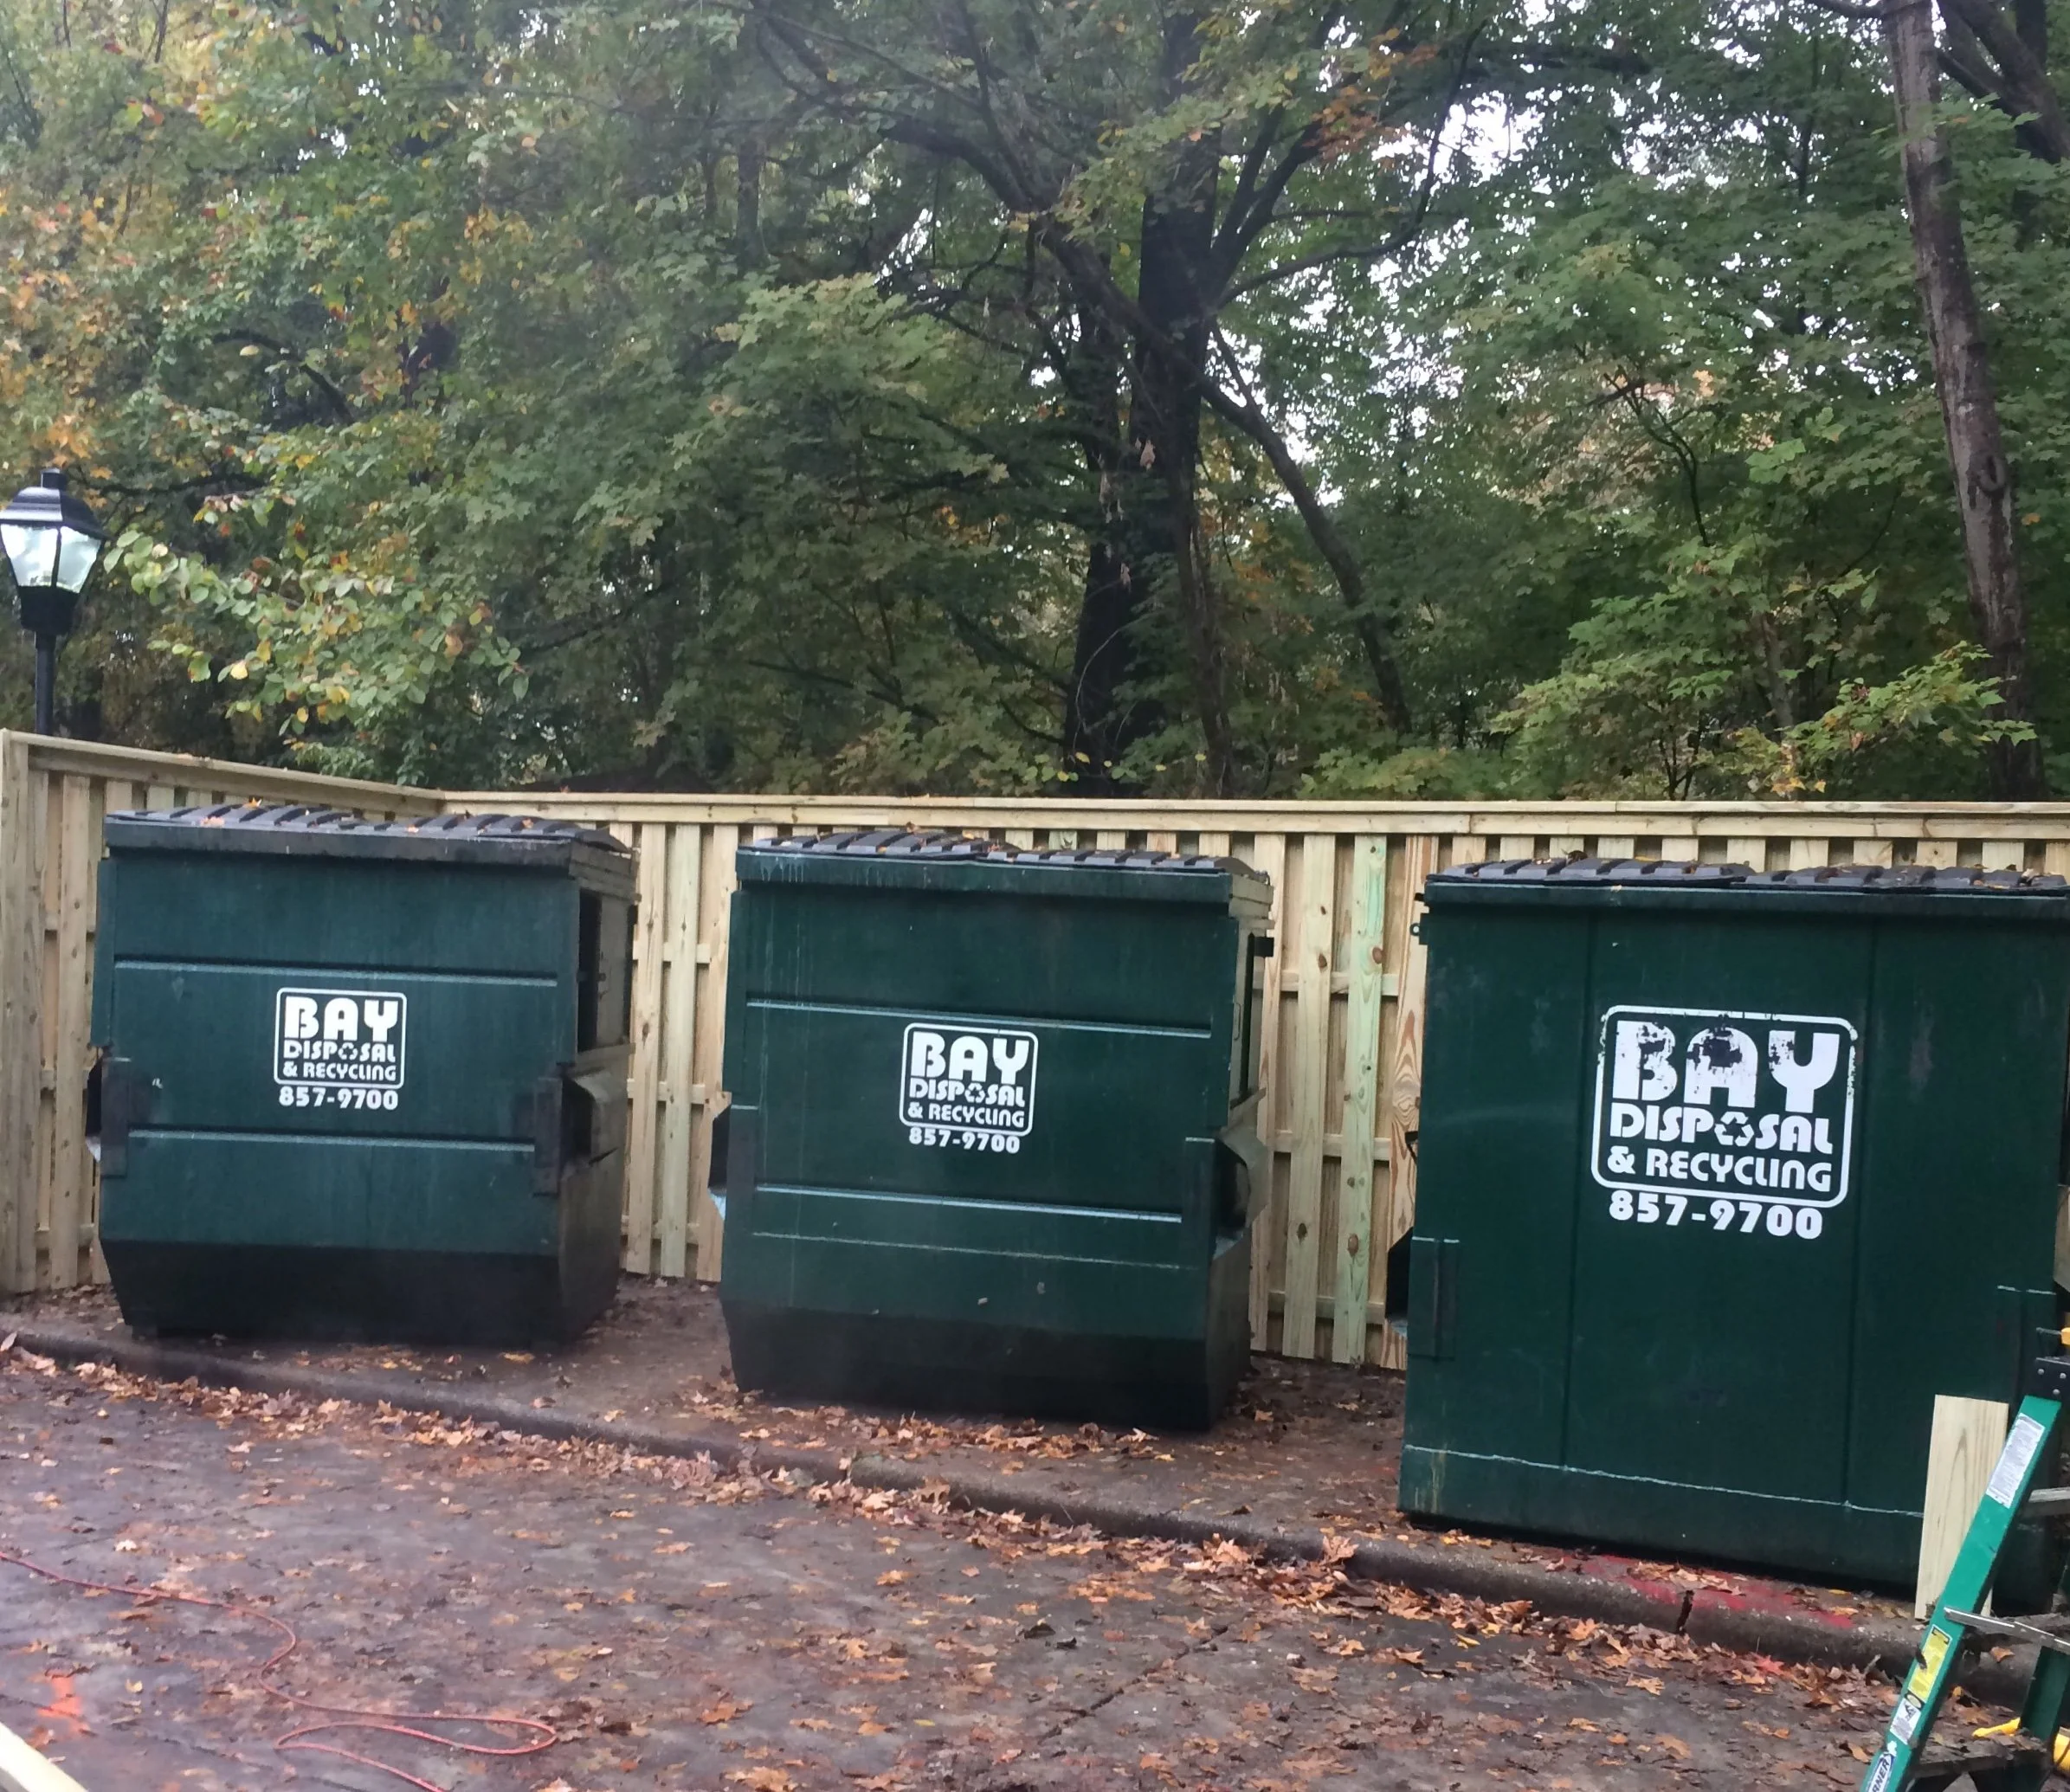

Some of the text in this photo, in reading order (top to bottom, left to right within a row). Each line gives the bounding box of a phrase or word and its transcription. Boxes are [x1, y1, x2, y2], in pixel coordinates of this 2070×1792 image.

[284, 996, 399, 1042] BAY
[282, 1060, 397, 1081] & RECYCLING
[910, 1031, 1030, 1086] BAY
[1612, 1020, 1840, 1113] BAY
[279, 1086, 399, 1111] 857-9700
[907, 1101, 1025, 1128] & RECYCLING
[909, 1126, 1021, 1155] 857-9700
[1607, 1145, 1833, 1193] & RECYCLING
[1609, 1189, 1823, 1240] 857-9700
